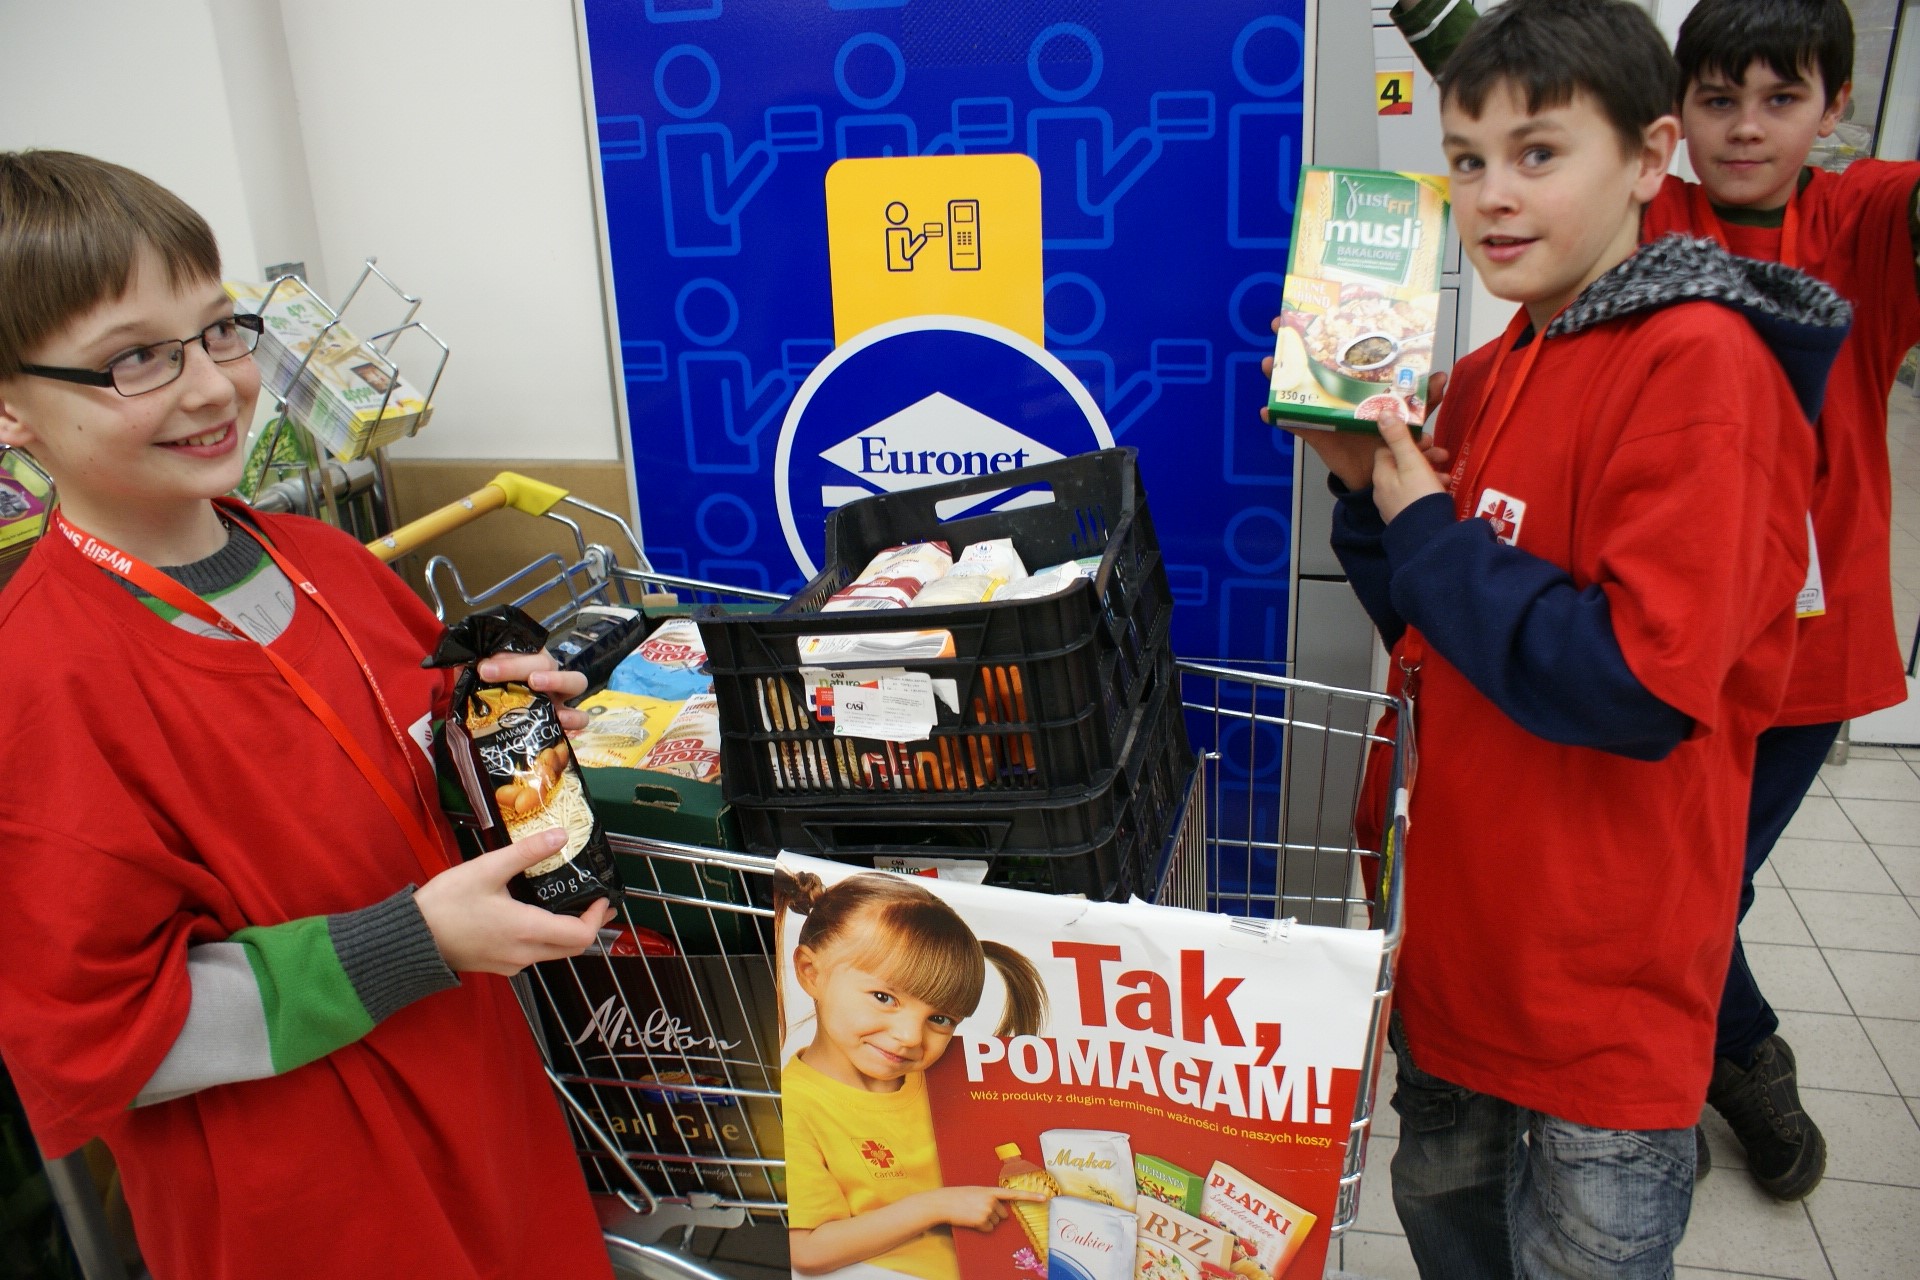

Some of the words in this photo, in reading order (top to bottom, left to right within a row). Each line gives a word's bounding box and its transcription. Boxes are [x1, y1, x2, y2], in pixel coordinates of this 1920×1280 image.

[1380, 79, 1402, 104] 4
[1324, 217, 1422, 249] musli
[1337, 246, 1401, 261] BAKALIOWE
[1280, 390, 1298, 401] 350
[1300, 394, 1306, 404] g
[857, 437, 1029, 475] Euronet
[83, 538, 133, 574] Wyślij
[846, 702, 864, 711] CASI
[537, 880, 566, 901] 250
[568, 877, 579, 893] g
[1052, 941, 1282, 1067] Tak,
[564, 994, 742, 1052] Milton
[962, 1034, 1333, 1126] POMAGAM!
[970, 1090, 998, 1101] Włóż
[1002, 1091, 1053, 1104] produkty
[1056, 1094, 1063, 1103] z
[1066, 1093, 1105, 1107] długim
[1109, 1097, 1164, 1117] terminem
[1167, 1110, 1219, 1132] ważności
[1222, 1125, 1238, 1136] do
[1241, 1128, 1292, 1144] naszych
[1295, 1134, 1332, 1149] koszy
[1046, 1148, 1117, 1172] Mąka
[1209, 1173, 1292, 1236] PŁATKI
[1056, 1218, 1113, 1253] Cukier
[1142, 1210, 1212, 1258] RYŻ
